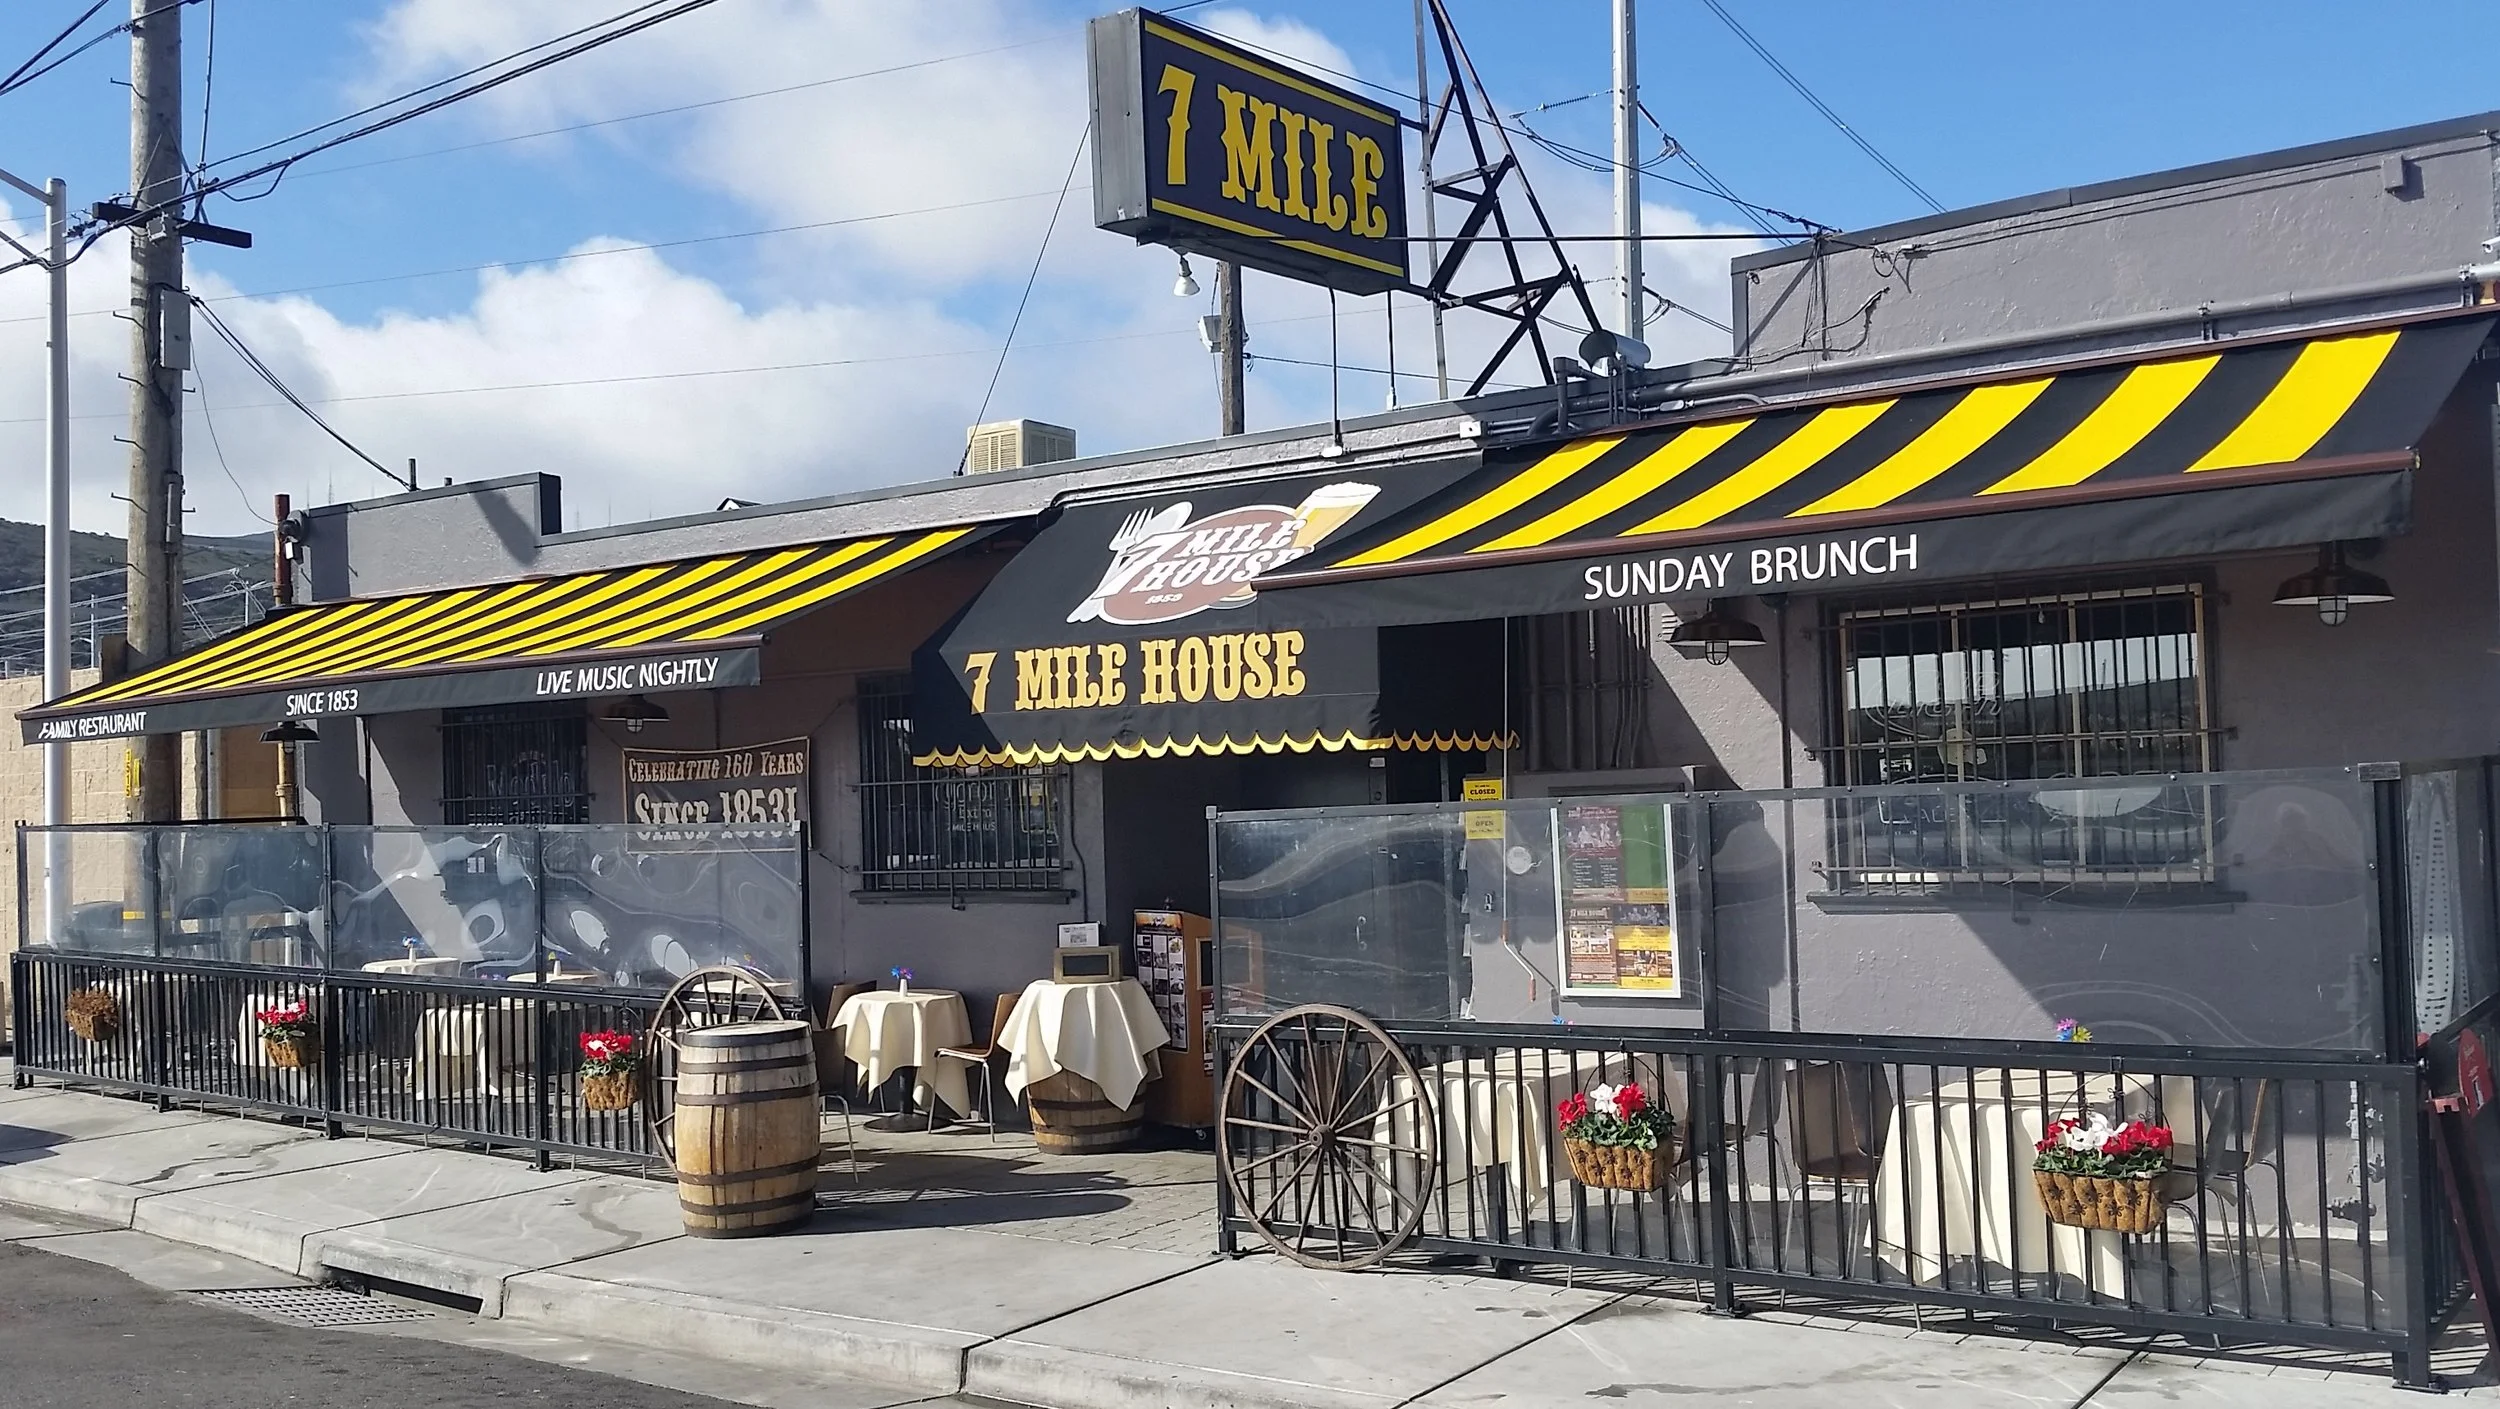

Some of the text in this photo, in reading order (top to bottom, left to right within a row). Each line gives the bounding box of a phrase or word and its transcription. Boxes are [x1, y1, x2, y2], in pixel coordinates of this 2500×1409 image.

[1157, 64, 1388, 238] 7 MILE
[1092, 519, 1308, 599] 7 MILE
[1583, 534, 1918, 601] SUNDAY BRUNCH
[536, 656, 719, 695] LIVE MUSIC NIGHTLY
[964, 630, 1307, 715] 7 MILE HOUSE
[37, 711, 148, 740] FAMILY RESTAURANT
[286, 688, 359, 717] SINCE 1853
[724, 752, 753, 779] 160
